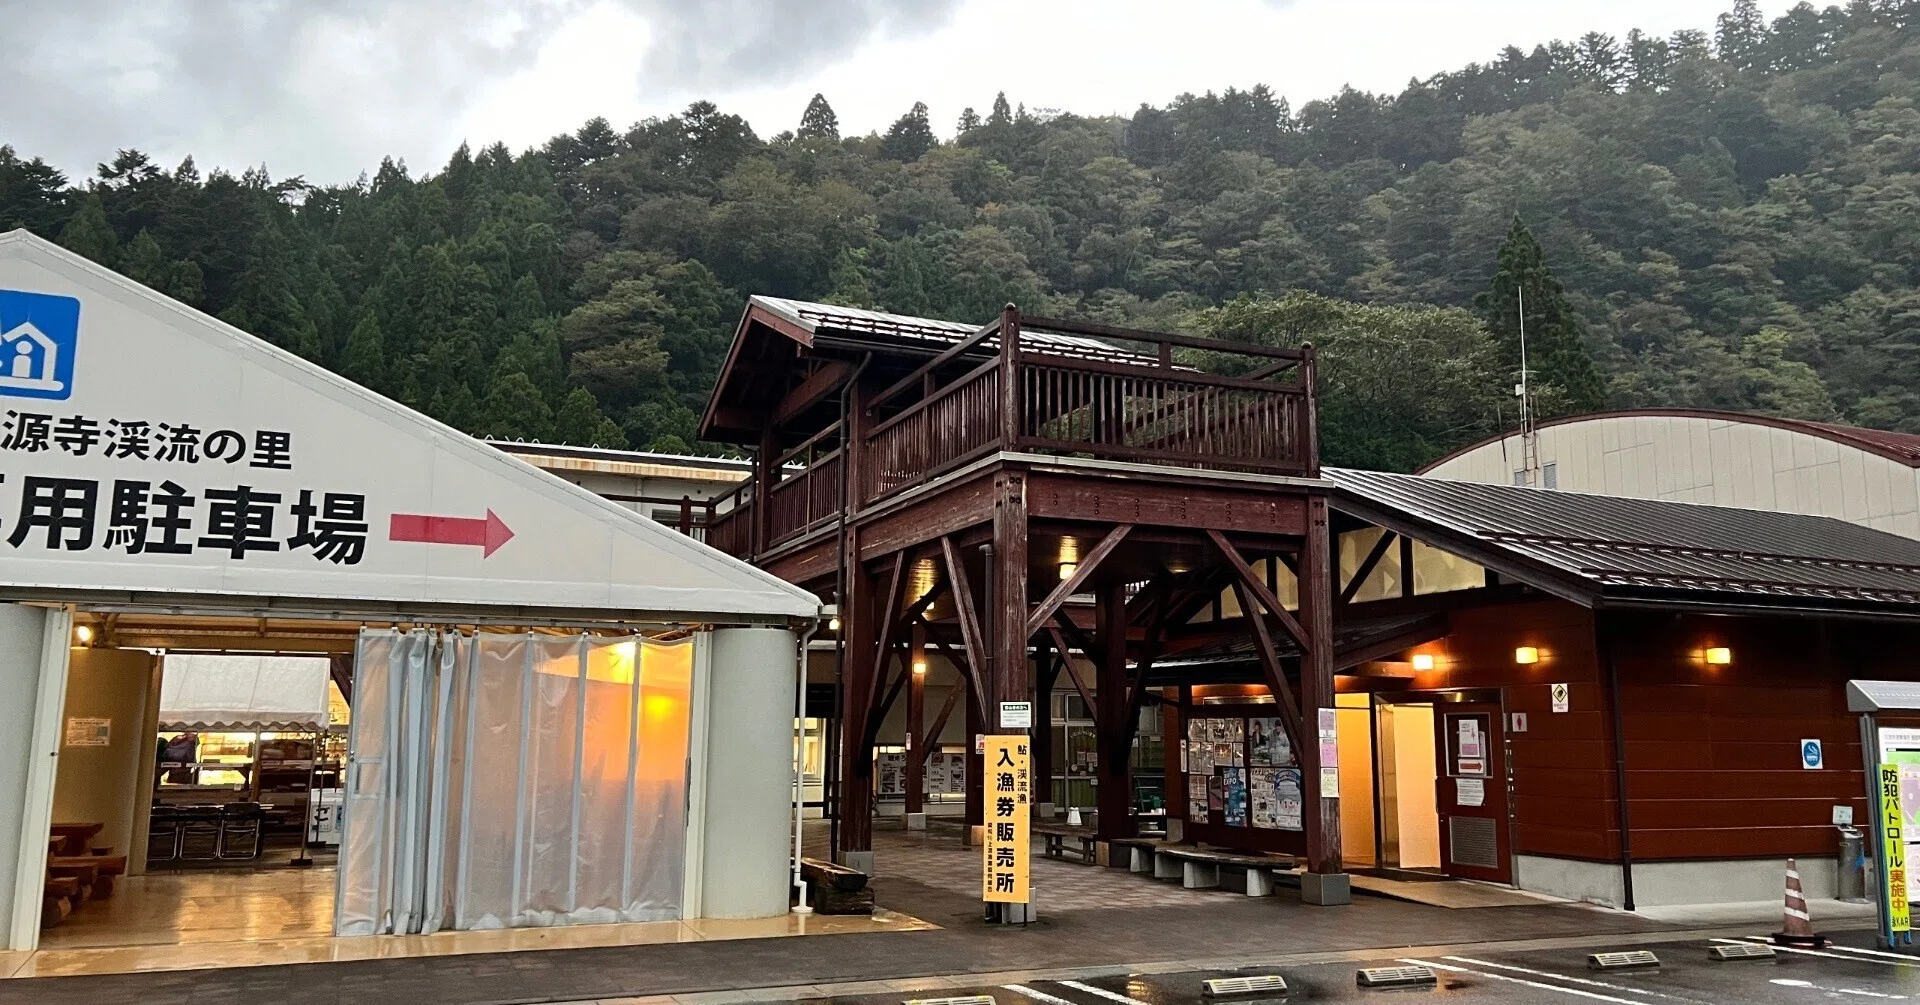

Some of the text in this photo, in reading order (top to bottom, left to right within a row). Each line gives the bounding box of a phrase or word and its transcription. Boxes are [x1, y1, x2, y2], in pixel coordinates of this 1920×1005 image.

[1, 410, 292, 470] 源寺渓流の里
[0, 474, 369, 565] 用駐車場
[996, 748, 1015, 893] 入漁券販売所
[1882, 769, 1906, 912] 防犯パトロール実施中
